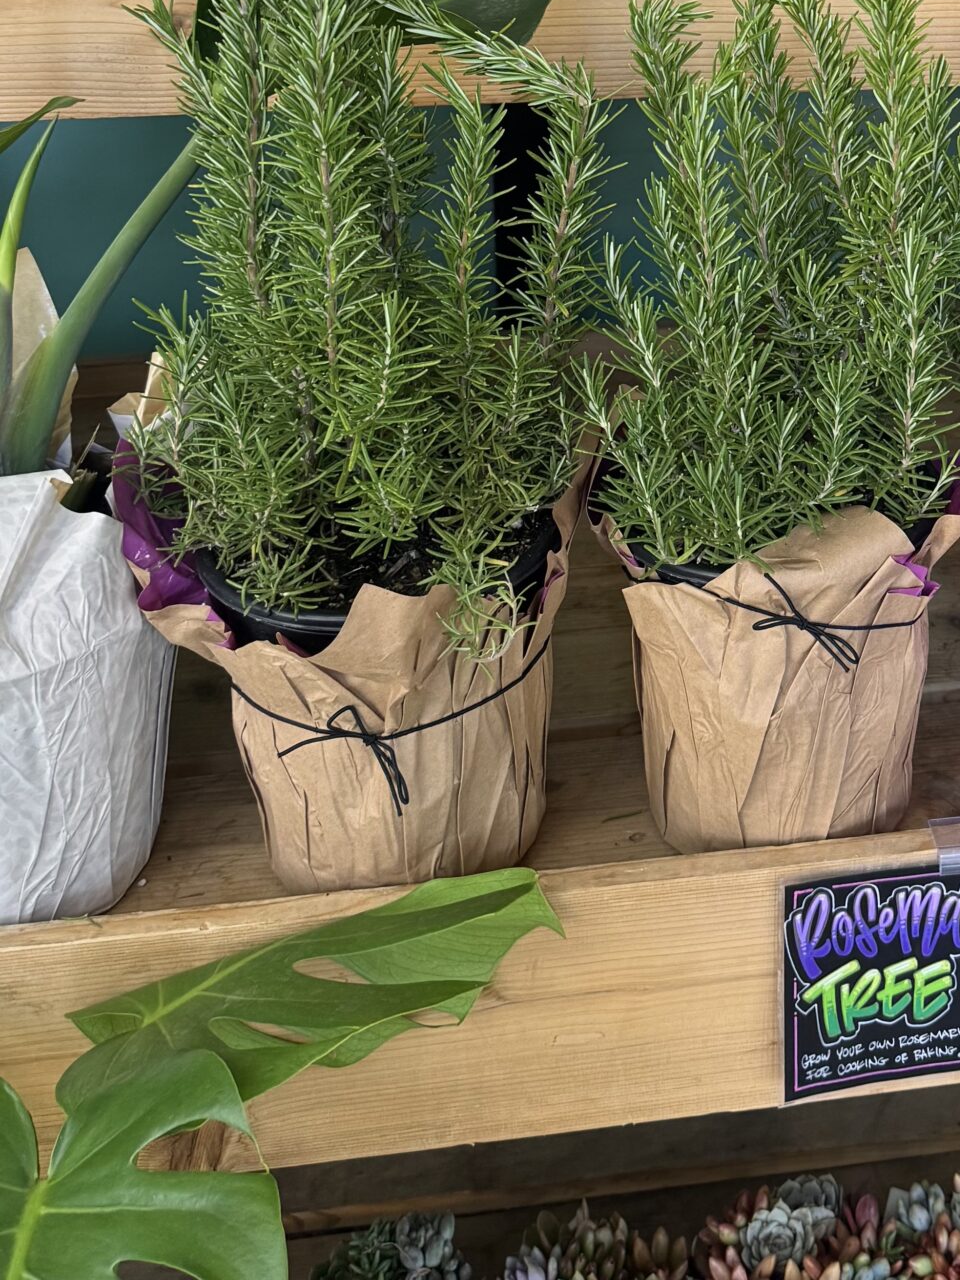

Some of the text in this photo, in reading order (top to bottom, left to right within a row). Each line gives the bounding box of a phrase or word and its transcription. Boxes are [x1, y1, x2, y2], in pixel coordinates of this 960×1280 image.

[802, 957, 953, 1039] TREE
[801, 1049, 831, 1069] GROW
[836, 1043, 865, 1060] YOUR
[868, 1037, 896, 1051] OWN
[805, 1065, 833, 1081] FOR
[837, 1056, 890, 1076] COOKING
